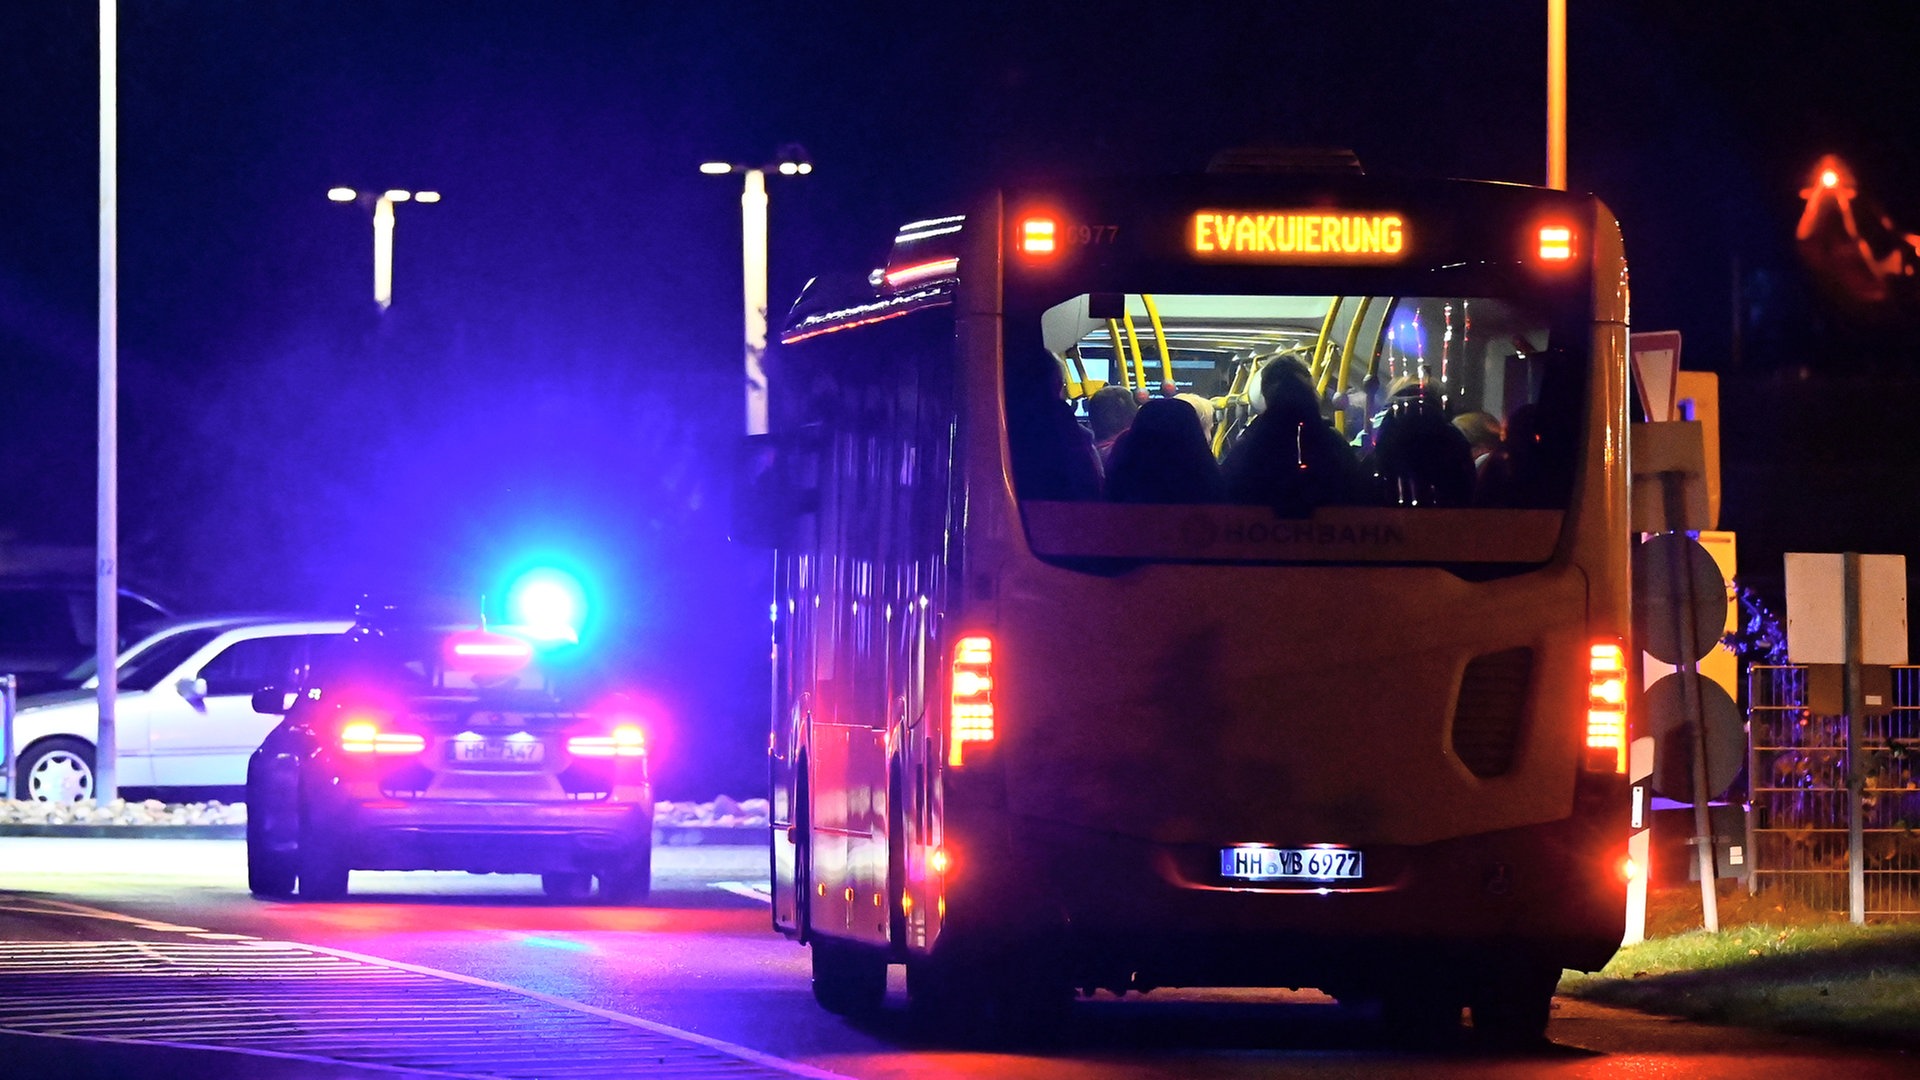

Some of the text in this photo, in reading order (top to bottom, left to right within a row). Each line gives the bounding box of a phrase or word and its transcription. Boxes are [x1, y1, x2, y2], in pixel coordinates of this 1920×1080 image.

[1194, 213, 1402, 254] EVAKUIERUNG
[1224, 523, 1405, 546] HOCHBAHN
[1236, 852, 1360, 876] HH YB 6977
